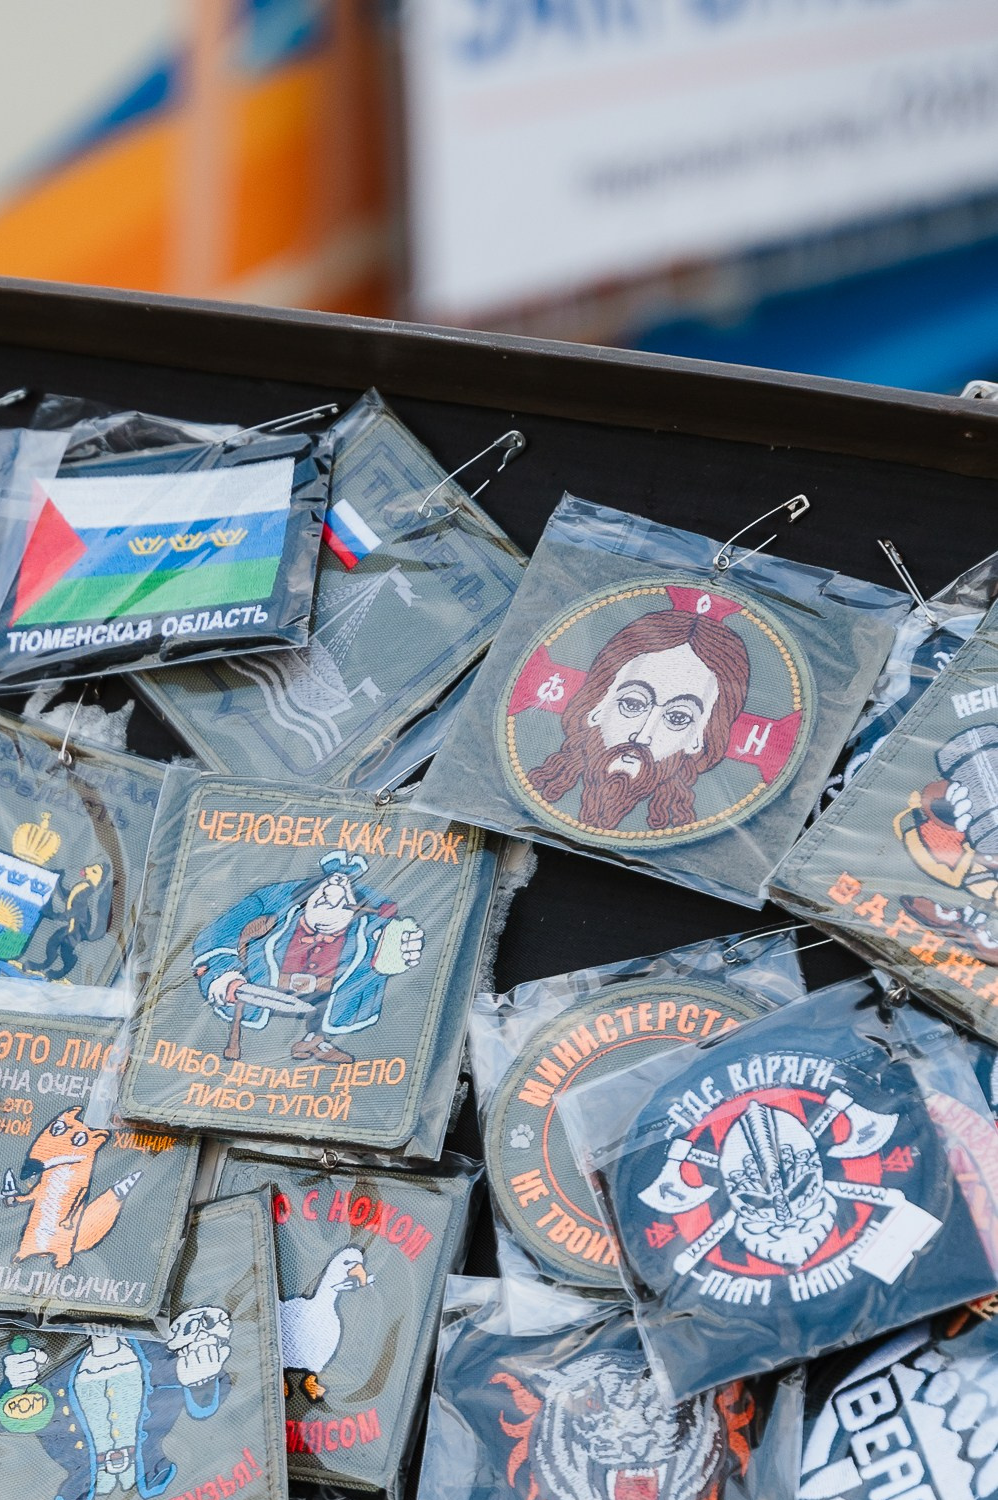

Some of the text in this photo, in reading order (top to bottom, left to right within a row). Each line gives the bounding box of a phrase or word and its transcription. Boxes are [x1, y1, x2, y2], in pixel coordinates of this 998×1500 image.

[7, 605, 268, 653] ТЮМЕНСКАЯ ОБЛАСТЬ
[199, 809, 463, 865] ЧЕЛОВЕК КАК НОЖ
[37, 1072, 110, 1100] ОЧЕН
[148, 1039, 407, 1093] ЛИБО ДЕЛАЕТ ДЕЛО
[184, 1082, 353, 1122] ЛИБО ТУПОЙ
[112, 1131, 178, 1152] ХИЩНИК
[510, 1168, 550, 1208] НЕ
[302, 1189, 434, 1262] С НОЖОМ
[18, 1270, 147, 1304] ЛИСИЧКУ!
[698, 1270, 771, 1305] ТАМ
[6, 1396, 47, 1418] РОМ
